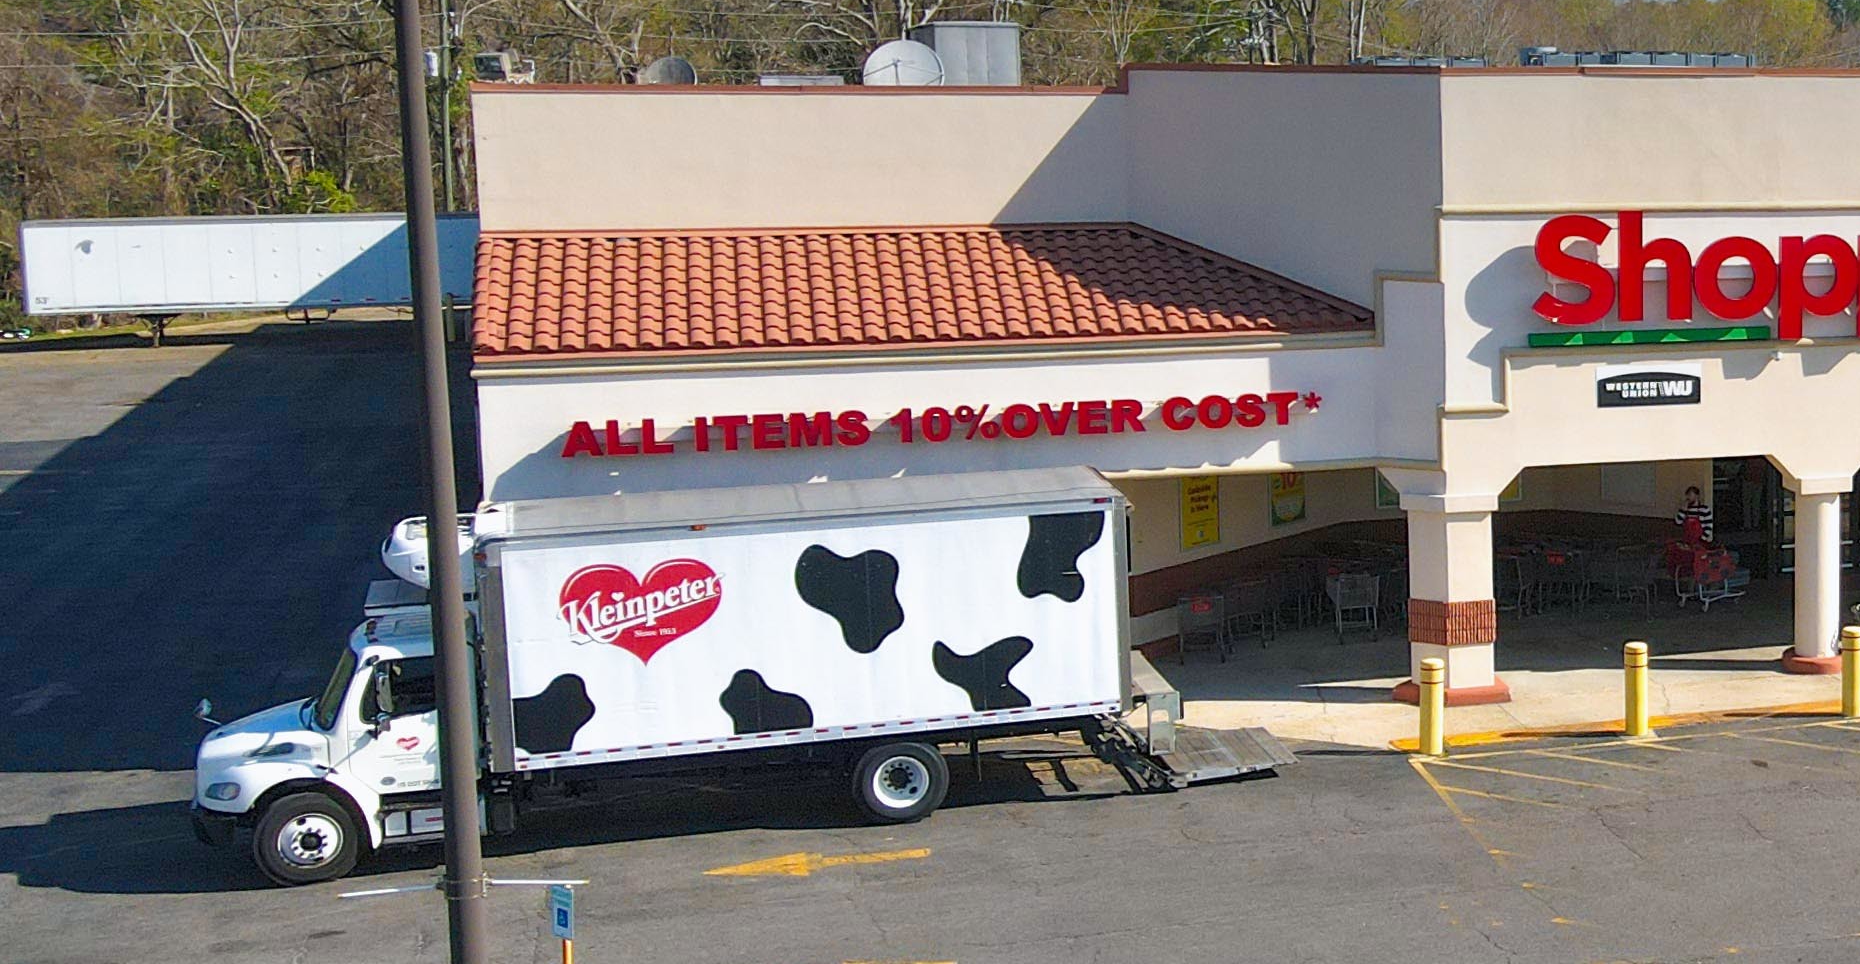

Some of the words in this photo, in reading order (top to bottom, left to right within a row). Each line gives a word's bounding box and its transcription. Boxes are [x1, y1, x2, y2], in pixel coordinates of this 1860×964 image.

[562, 419, 674, 457] ALL
[695, 410, 872, 452] ITEMS
[556, 572, 725, 645] Kleinpeter
